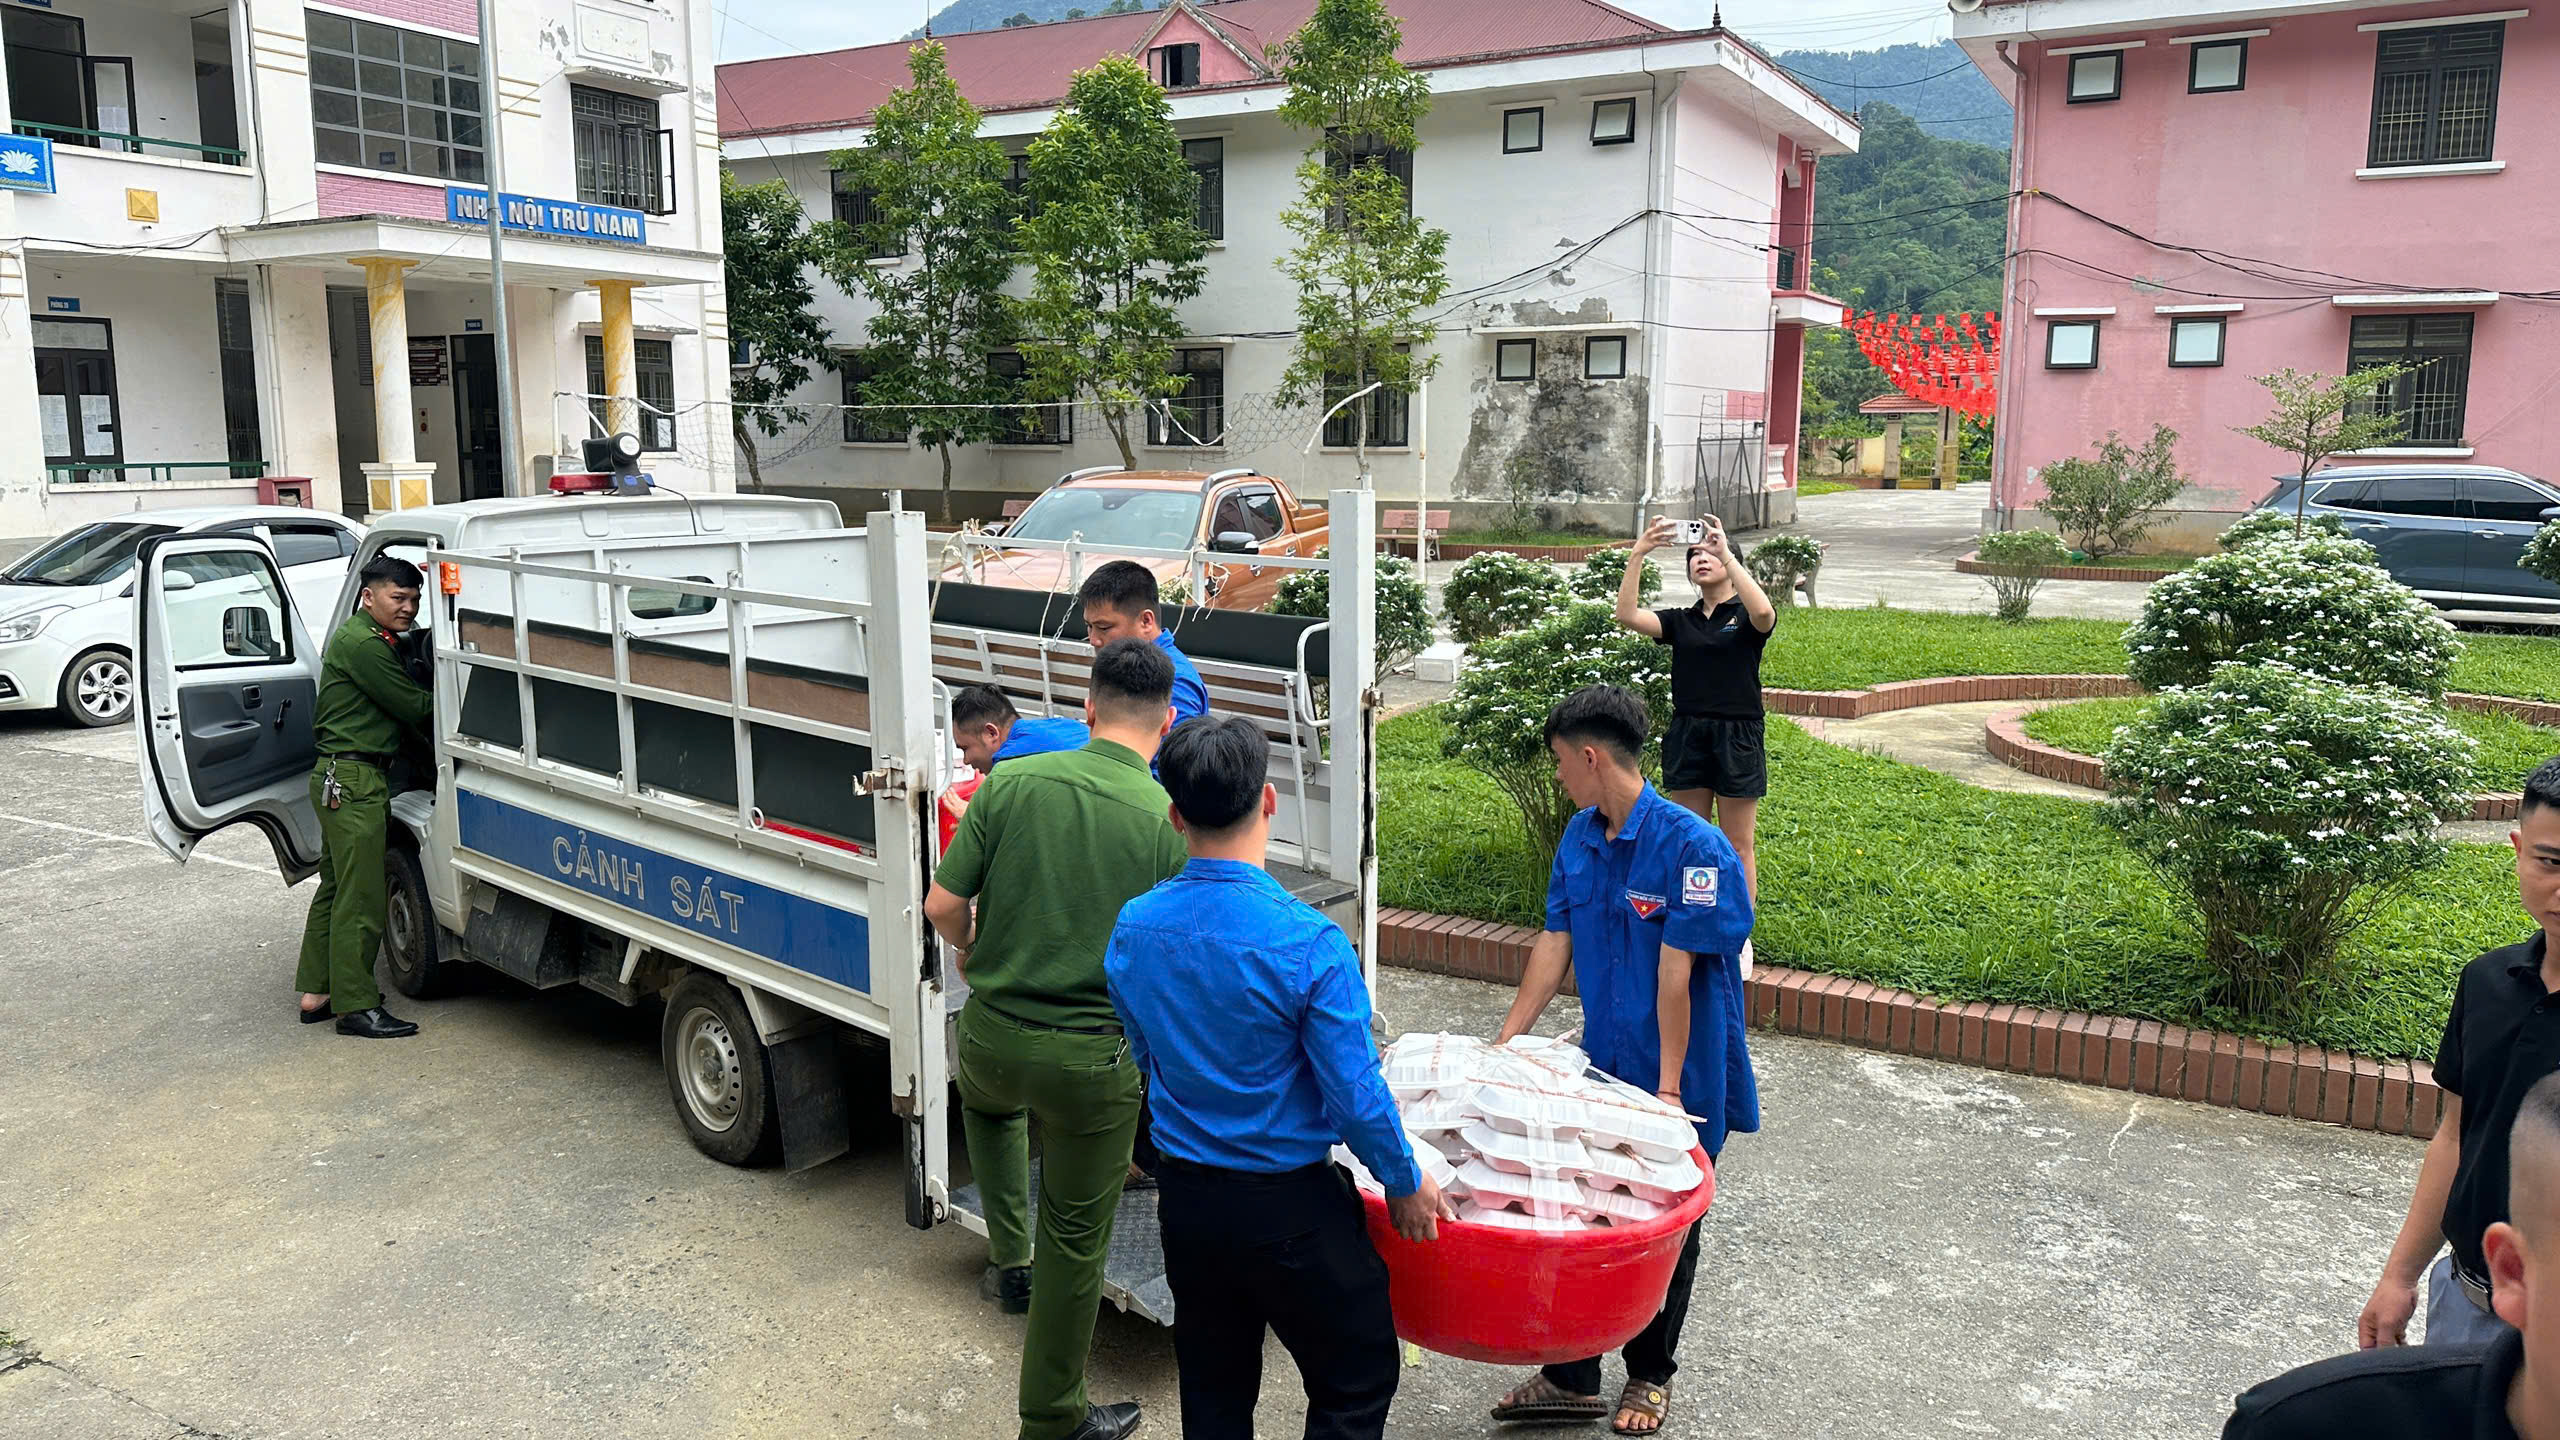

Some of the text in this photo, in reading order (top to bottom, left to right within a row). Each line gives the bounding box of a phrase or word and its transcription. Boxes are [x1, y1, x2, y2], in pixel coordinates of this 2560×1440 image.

[508, 197, 545, 231] NỘI
[549, 205, 589, 232] TRÚ
[593, 212, 639, 239] NAM
[552, 830, 745, 934] CẢNH SÁT
